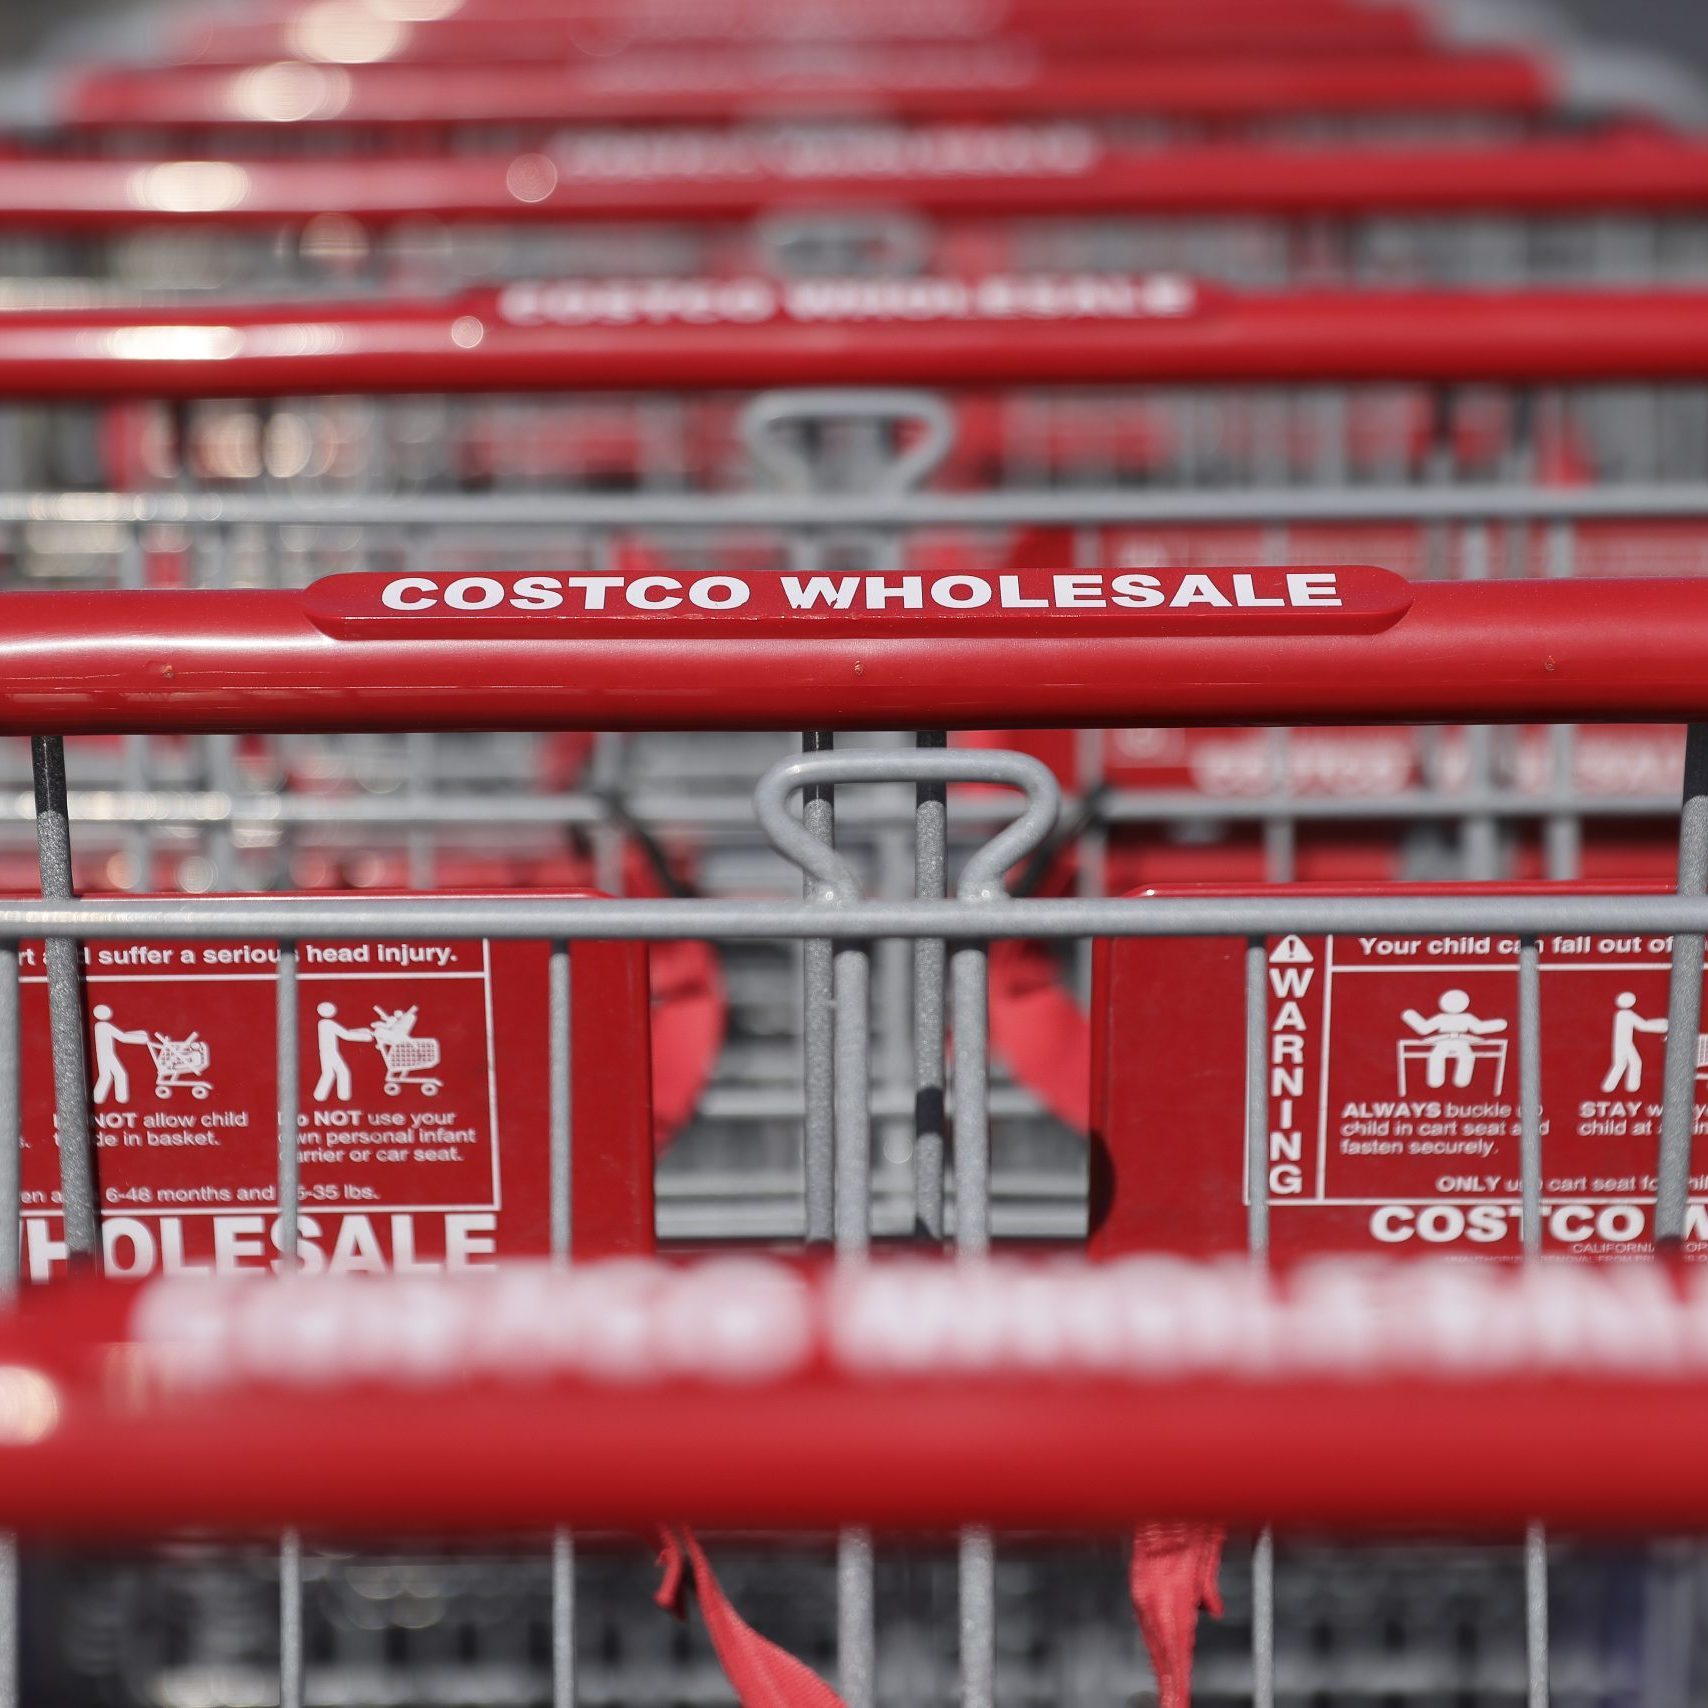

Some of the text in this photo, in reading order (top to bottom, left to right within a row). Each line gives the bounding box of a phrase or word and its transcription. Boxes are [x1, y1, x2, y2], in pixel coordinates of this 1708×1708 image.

[381, 573, 1343, 611] COSTCO WHOLESALE
[1359, 937, 1421, 955] Your
[1427, 937, 1491, 955] child
[1552, 936, 1591, 954] fall
[1599, 937, 1642, 954] out
[1649, 936, 1675, 954] of
[98, 945, 173, 965] suffer
[180, 949, 196, 965] a
[203, 945, 300, 964] seriou
[305, 944, 371, 963] head
[377, 944, 458, 966] injury.
[1268, 967, 1314, 1195] WARNING
[1341, 1102, 1441, 1119] ALWAYS
[1446, 1102, 1512, 1118] buckle
[1579, 1101, 1642, 1118] STAY
[143, 1112, 196, 1128] allow
[200, 1111, 249, 1128] child
[313, 1110, 362, 1127] NOT
[368, 1113, 405, 1126] use
[410, 1112, 456, 1129] your
[1340, 1120, 1550, 1137] child in cart seat ad
[1577, 1119, 1627, 1136] child
[1631, 1120, 1653, 1136] at
[124, 1130, 142, 1146] in
[147, 1130, 221, 1147] basket.
[326, 1128, 414, 1147] personal
[419, 1127, 477, 1144] infant
[279, 1146, 464, 1162] arrier or car seat.
[1340, 1138, 1499, 1158] fasten securely.
[157, 1186, 232, 1202] months
[237, 1185, 276, 1201] and
[344, 1183, 381, 1200] lbs.
[1435, 1175, 1501, 1192] ONLY
[1548, 1177, 1587, 1192] cart
[1592, 1176, 1636, 1192] seat
[19, 1213, 497, 1283] HOLESALE
[1572, 1242, 1656, 1255] CALIFORNI
